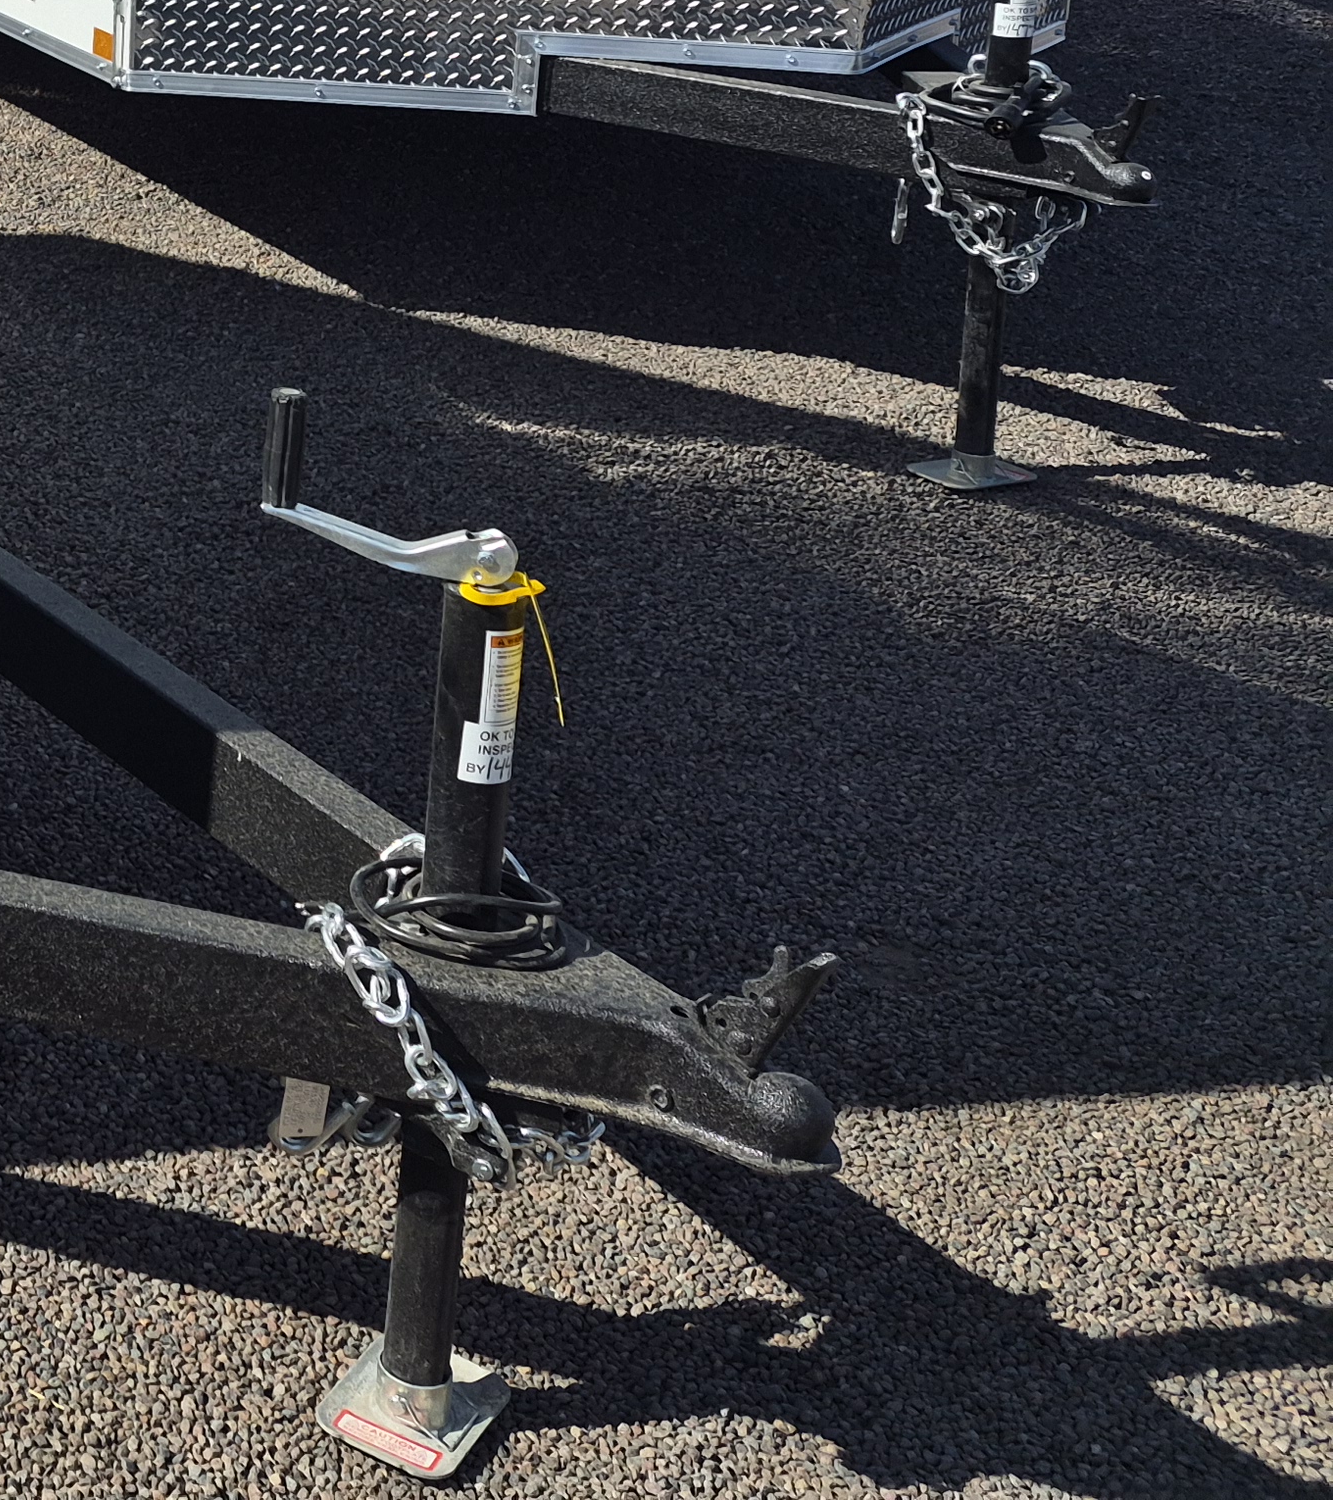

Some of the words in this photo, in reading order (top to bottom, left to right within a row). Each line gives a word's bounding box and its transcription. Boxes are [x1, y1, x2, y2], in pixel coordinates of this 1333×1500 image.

[480, 731, 500, 741] OK
[478, 742, 513, 755] INSPE
[466, 762, 486, 774] BY
[486, 756, 511, 780] 144
[361, 1424, 417, 1451] CAUTION
